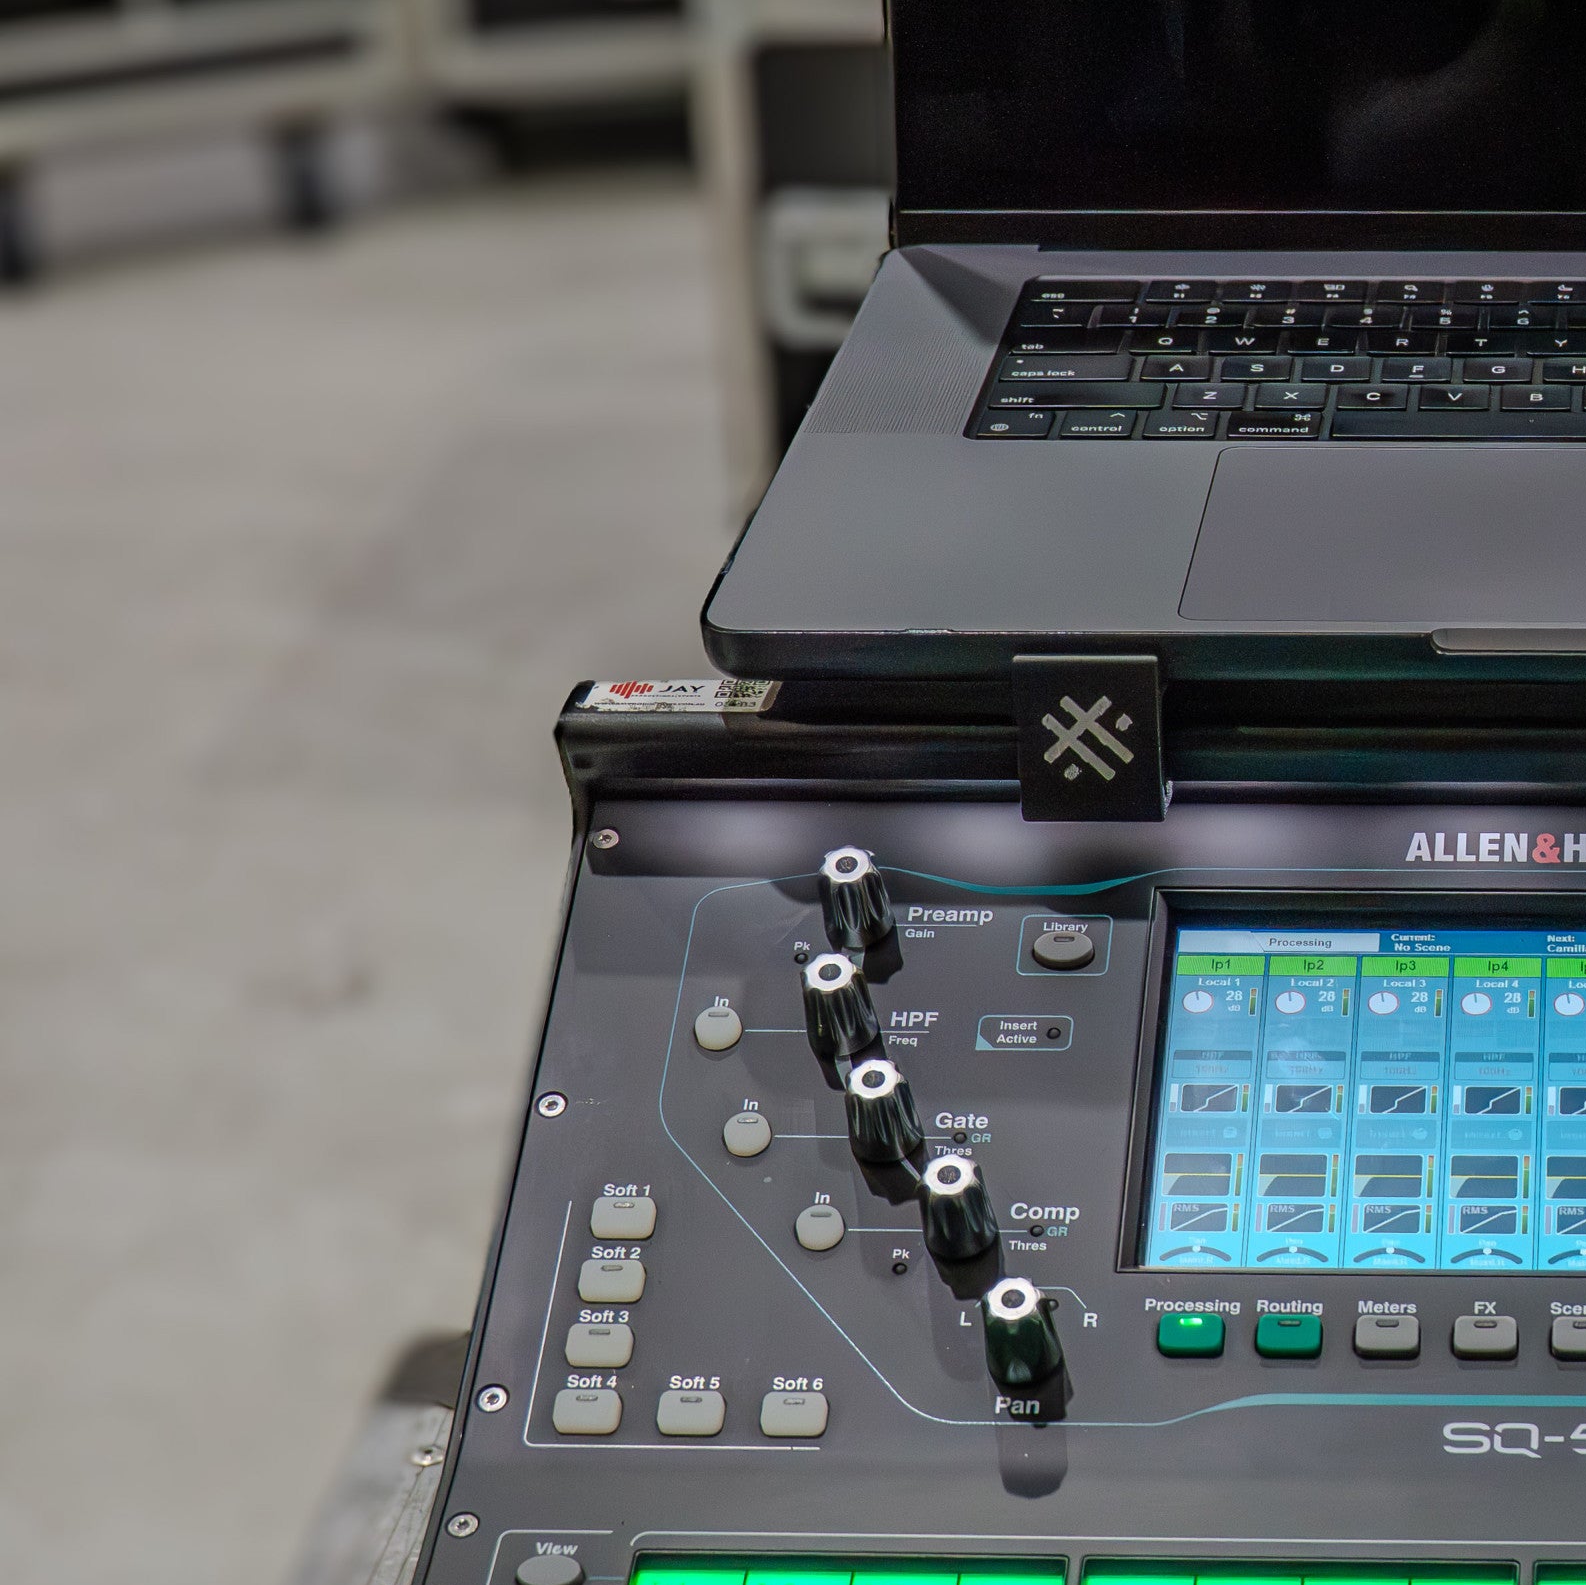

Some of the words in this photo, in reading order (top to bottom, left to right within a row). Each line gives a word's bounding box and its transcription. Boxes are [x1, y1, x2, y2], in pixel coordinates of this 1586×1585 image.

[1011, 370, 1044, 378] caps
[1000, 396, 1034, 404] shift
[1071, 424, 1122, 432] control
[1159, 425, 1205, 434] option
[1238, 425, 1309, 433] command
[659, 685, 705, 693] JAY
[907, 907, 994, 924] Preamp
[1043, 920, 1089, 933] Library
[905, 928, 935, 939] Gain
[1547, 935, 1576, 943] Next:
[794, 941, 811, 951] Pk
[1269, 937, 1332, 950] Processing
[1394, 943, 1411, 951] No
[1414, 943, 1452, 952] Scene
[714, 997, 730, 1007] In
[890, 1011, 939, 1028] HPF
[999, 1021, 1038, 1031] Insert
[889, 1035, 918, 1046] Freq
[996, 1033, 1037, 1044] Active
[743, 1099, 759, 1110] In
[935, 1113, 989, 1129] Gate
[971, 1133, 992, 1144] GR
[935, 1145, 972, 1156] Thres
[604, 1184, 640, 1197] Soft
[643, 1184, 651, 1196] 1
[815, 1191, 831, 1203] In
[1010, 1202, 1080, 1221] Comp
[1047, 1226, 1068, 1237] GR
[1009, 1241, 1047, 1251] Thres
[591, 1247, 627, 1260] Soft
[630, 1247, 640, 1259] 2
[892, 1249, 910, 1259] Pk
[1144, 1299, 1241, 1315] Processing
[1256, 1300, 1324, 1315] Routing
[1358, 1300, 1417, 1314] Meters
[1473, 1302, 1497, 1314] FX
[579, 1310, 615, 1323] Soft
[618, 1310, 629, 1322] 3
[960, 1312, 971, 1327] L
[1083, 1312, 1098, 1327] R
[567, 1375, 603, 1388] Soft
[606, 1375, 617, 1387] 4
[669, 1376, 705, 1389] Soft
[709, 1376, 720, 1388] 5
[773, 1377, 809, 1390] Soft
[813, 1377, 823, 1390] 6
[994, 1396, 1040, 1414] Pan
[535, 1542, 579, 1556] View
